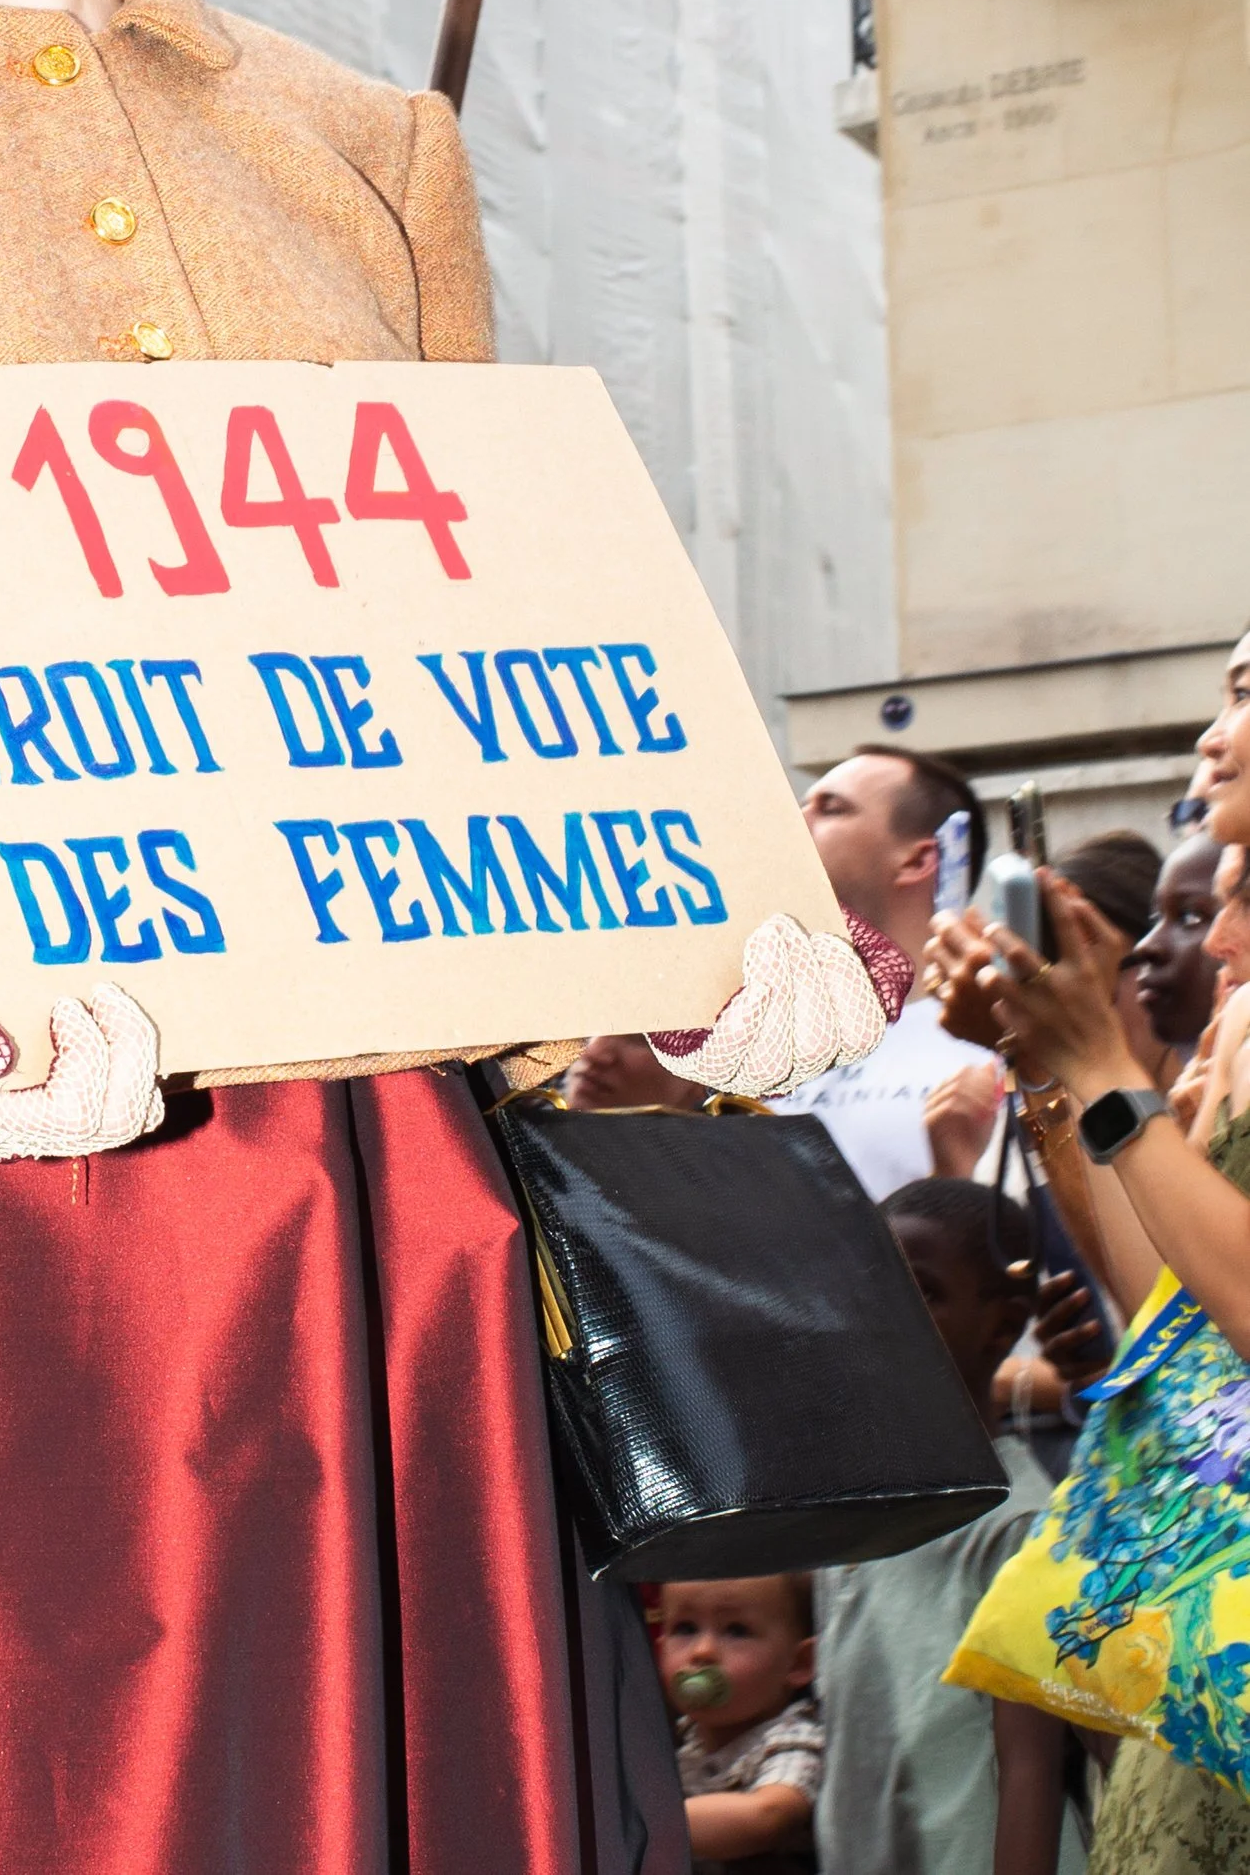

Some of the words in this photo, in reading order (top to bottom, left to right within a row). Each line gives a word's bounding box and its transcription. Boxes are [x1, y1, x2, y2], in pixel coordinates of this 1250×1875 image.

[11, 400, 471, 599] 1944
[248, 652, 404, 770] DE
[417, 643, 689, 763] VOTE
[275, 809, 729, 944] FEMMES
